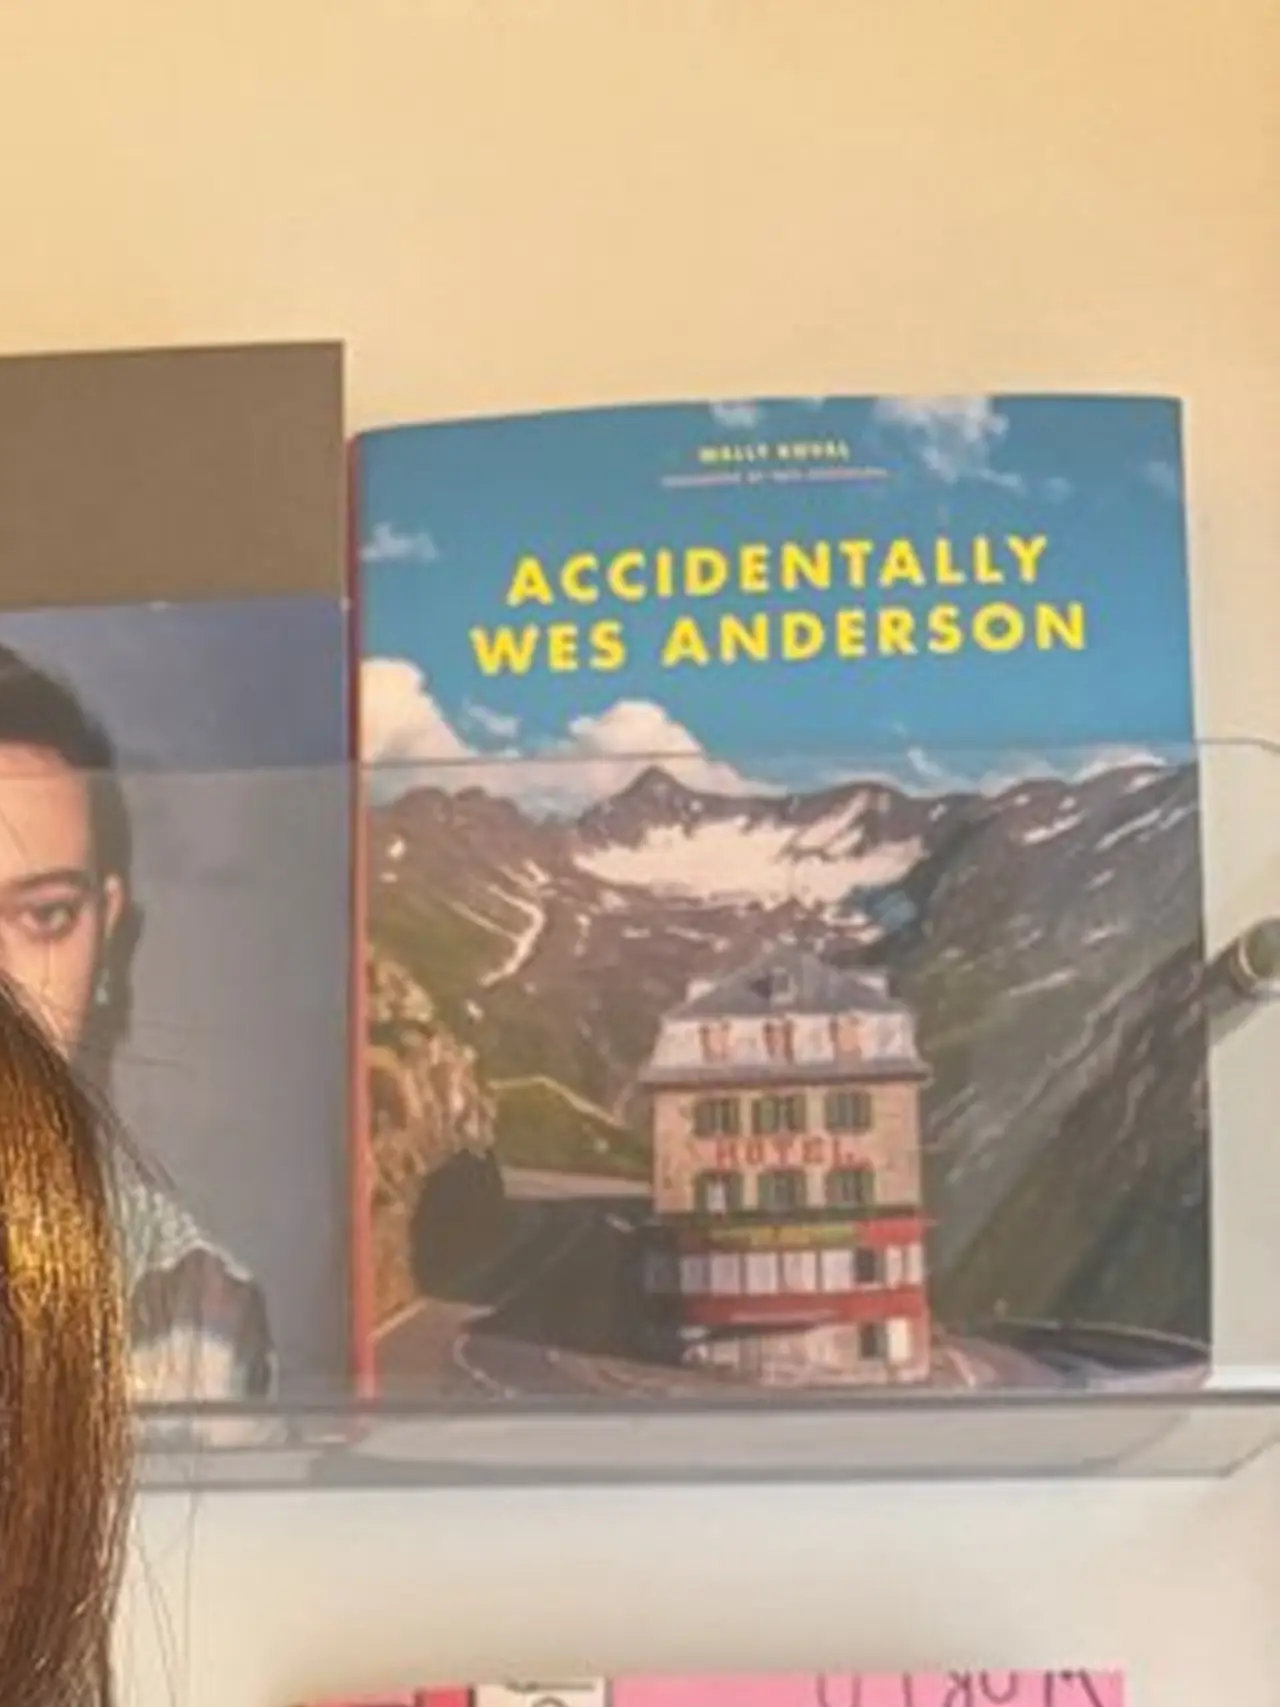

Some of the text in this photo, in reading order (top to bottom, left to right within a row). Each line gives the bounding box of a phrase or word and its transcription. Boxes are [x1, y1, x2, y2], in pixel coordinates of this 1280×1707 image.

[506, 535, 1047, 607] ACCIDENTALLY
[469, 601, 1088, 676] WES ANDERSON
